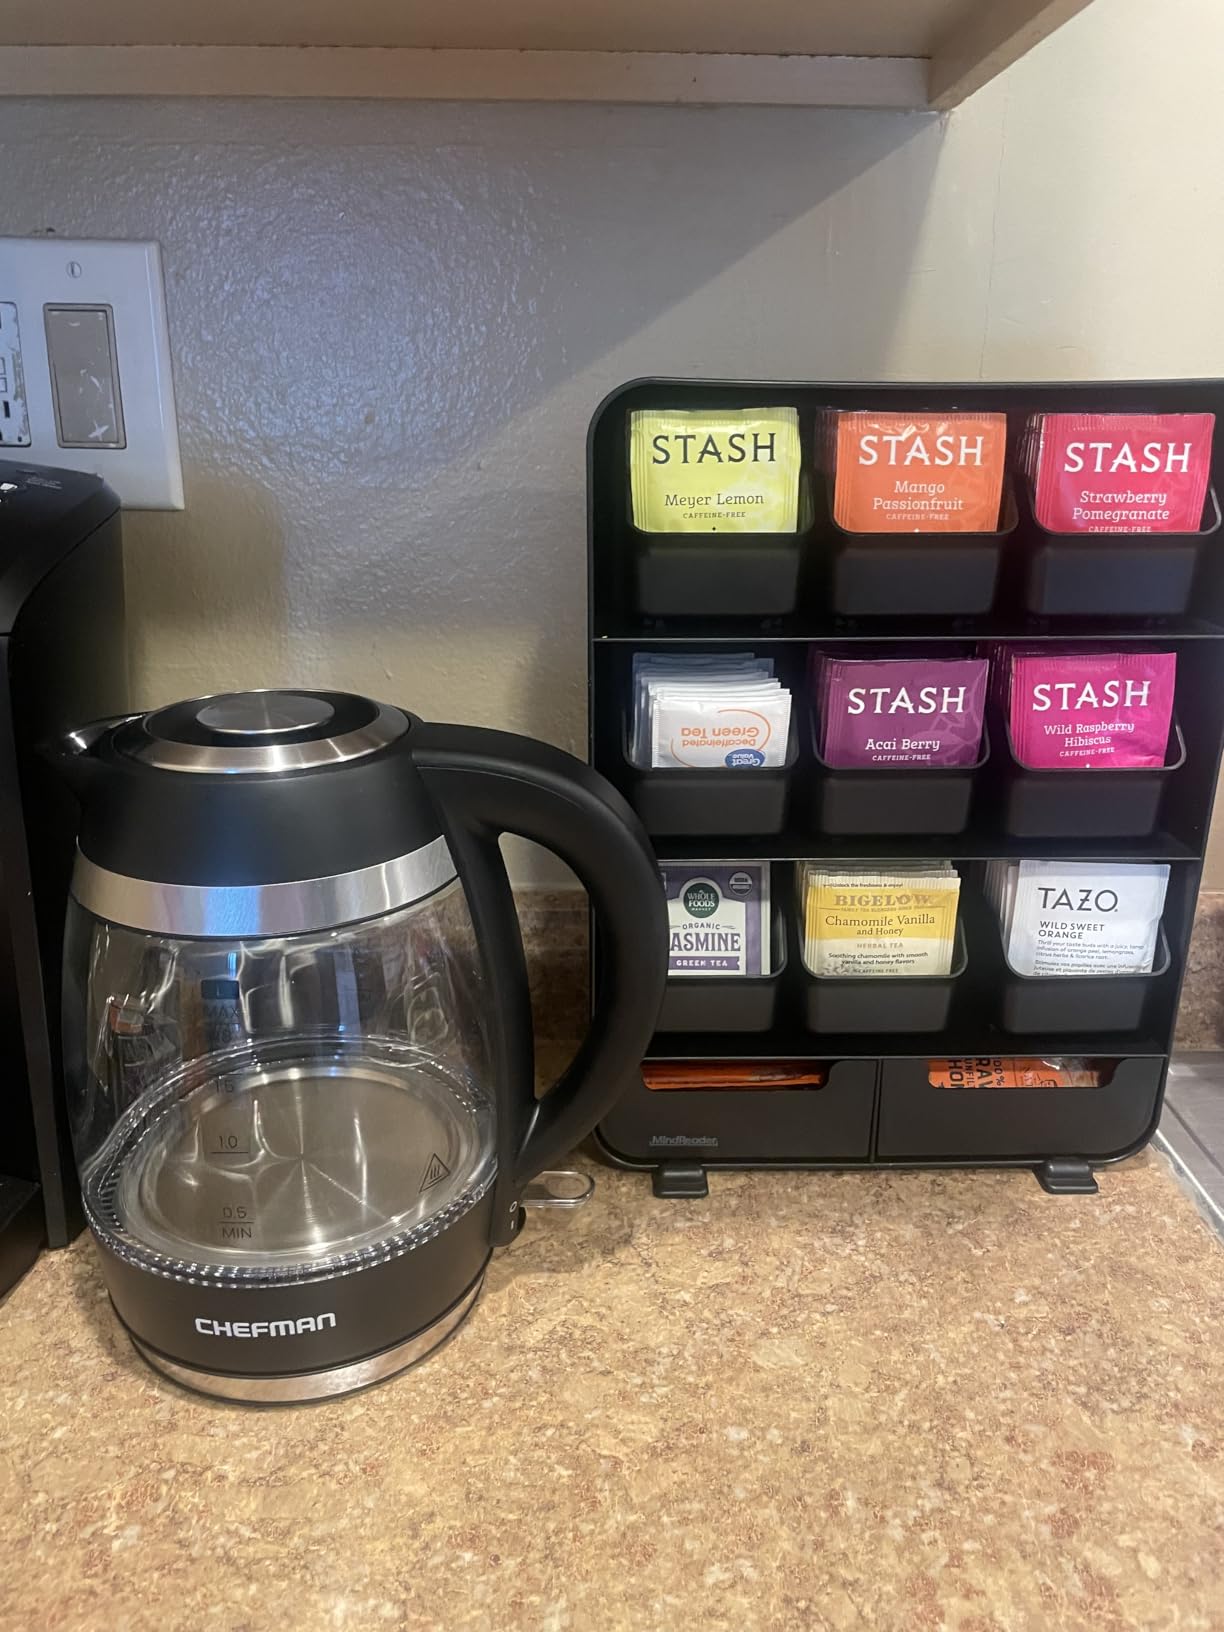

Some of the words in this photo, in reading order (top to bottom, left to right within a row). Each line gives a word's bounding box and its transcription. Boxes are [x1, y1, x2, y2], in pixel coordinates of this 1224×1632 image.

[652, 432, 777, 465] STASH
[858, 434, 985, 466] STASH
[1064, 441, 1193, 473] STASH
[894, 480, 945, 496] Mango
[664, 494, 712, 508] Meyer
[716, 493, 764, 506] Lemon
[872, 497, 964, 510] Passionfruit
[1080, 490, 1168, 506] Strawberry
[1072, 507, 1170, 523] Pomegranate
[847, 686, 967, 714] STASH
[1032, 680, 1152, 712] STASH
[680, 727, 708, 738] Tea
[712, 726, 760, 738] Green
[1044, 724, 1072, 736] Wild
[1076, 722, 1135, 734] Raspberry
[682, 738, 756, 747] Decaffeinated
[865, 738, 896, 750] Acai
[901, 738, 940, 751] Berry
[1064, 736, 1112, 747] Hibiscus
[1059, 747, 1115, 757] CAFFEINE-FREE
[687, 892, 715, 900] WHOLE
[834, 894, 930, 907] BIGELOW
[825, 915, 893, 927] Chamomile
[897, 913, 935, 924] Vanilla
[1040, 920, 1067, 930] WILD
[1070, 922, 1105, 932] SWEET
[875, 928, 904, 936] Honey
[1038, 930, 1083, 939] ORANGE
[670, 932, 741, 952] ASMINE
[222, 1227, 252, 1238] MIN
[194, 1312, 336, 1338] CHEFMAN
